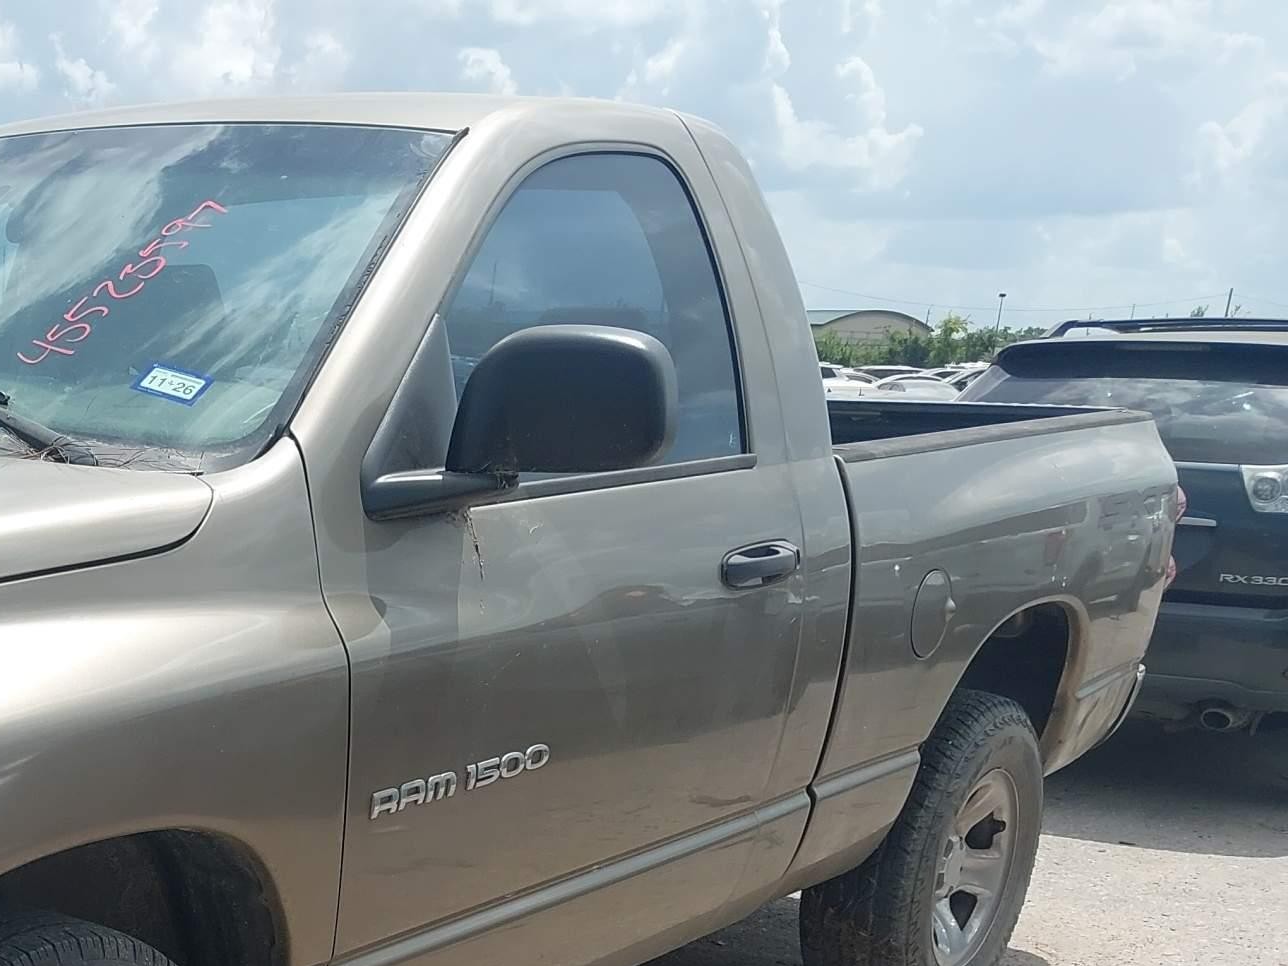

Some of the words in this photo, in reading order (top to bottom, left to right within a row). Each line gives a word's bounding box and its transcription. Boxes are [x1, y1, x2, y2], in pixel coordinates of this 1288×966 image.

[1219, 573, 1249, 584] RX
[369, 771, 457, 820] RAM
[465, 743, 550, 791] 1500
